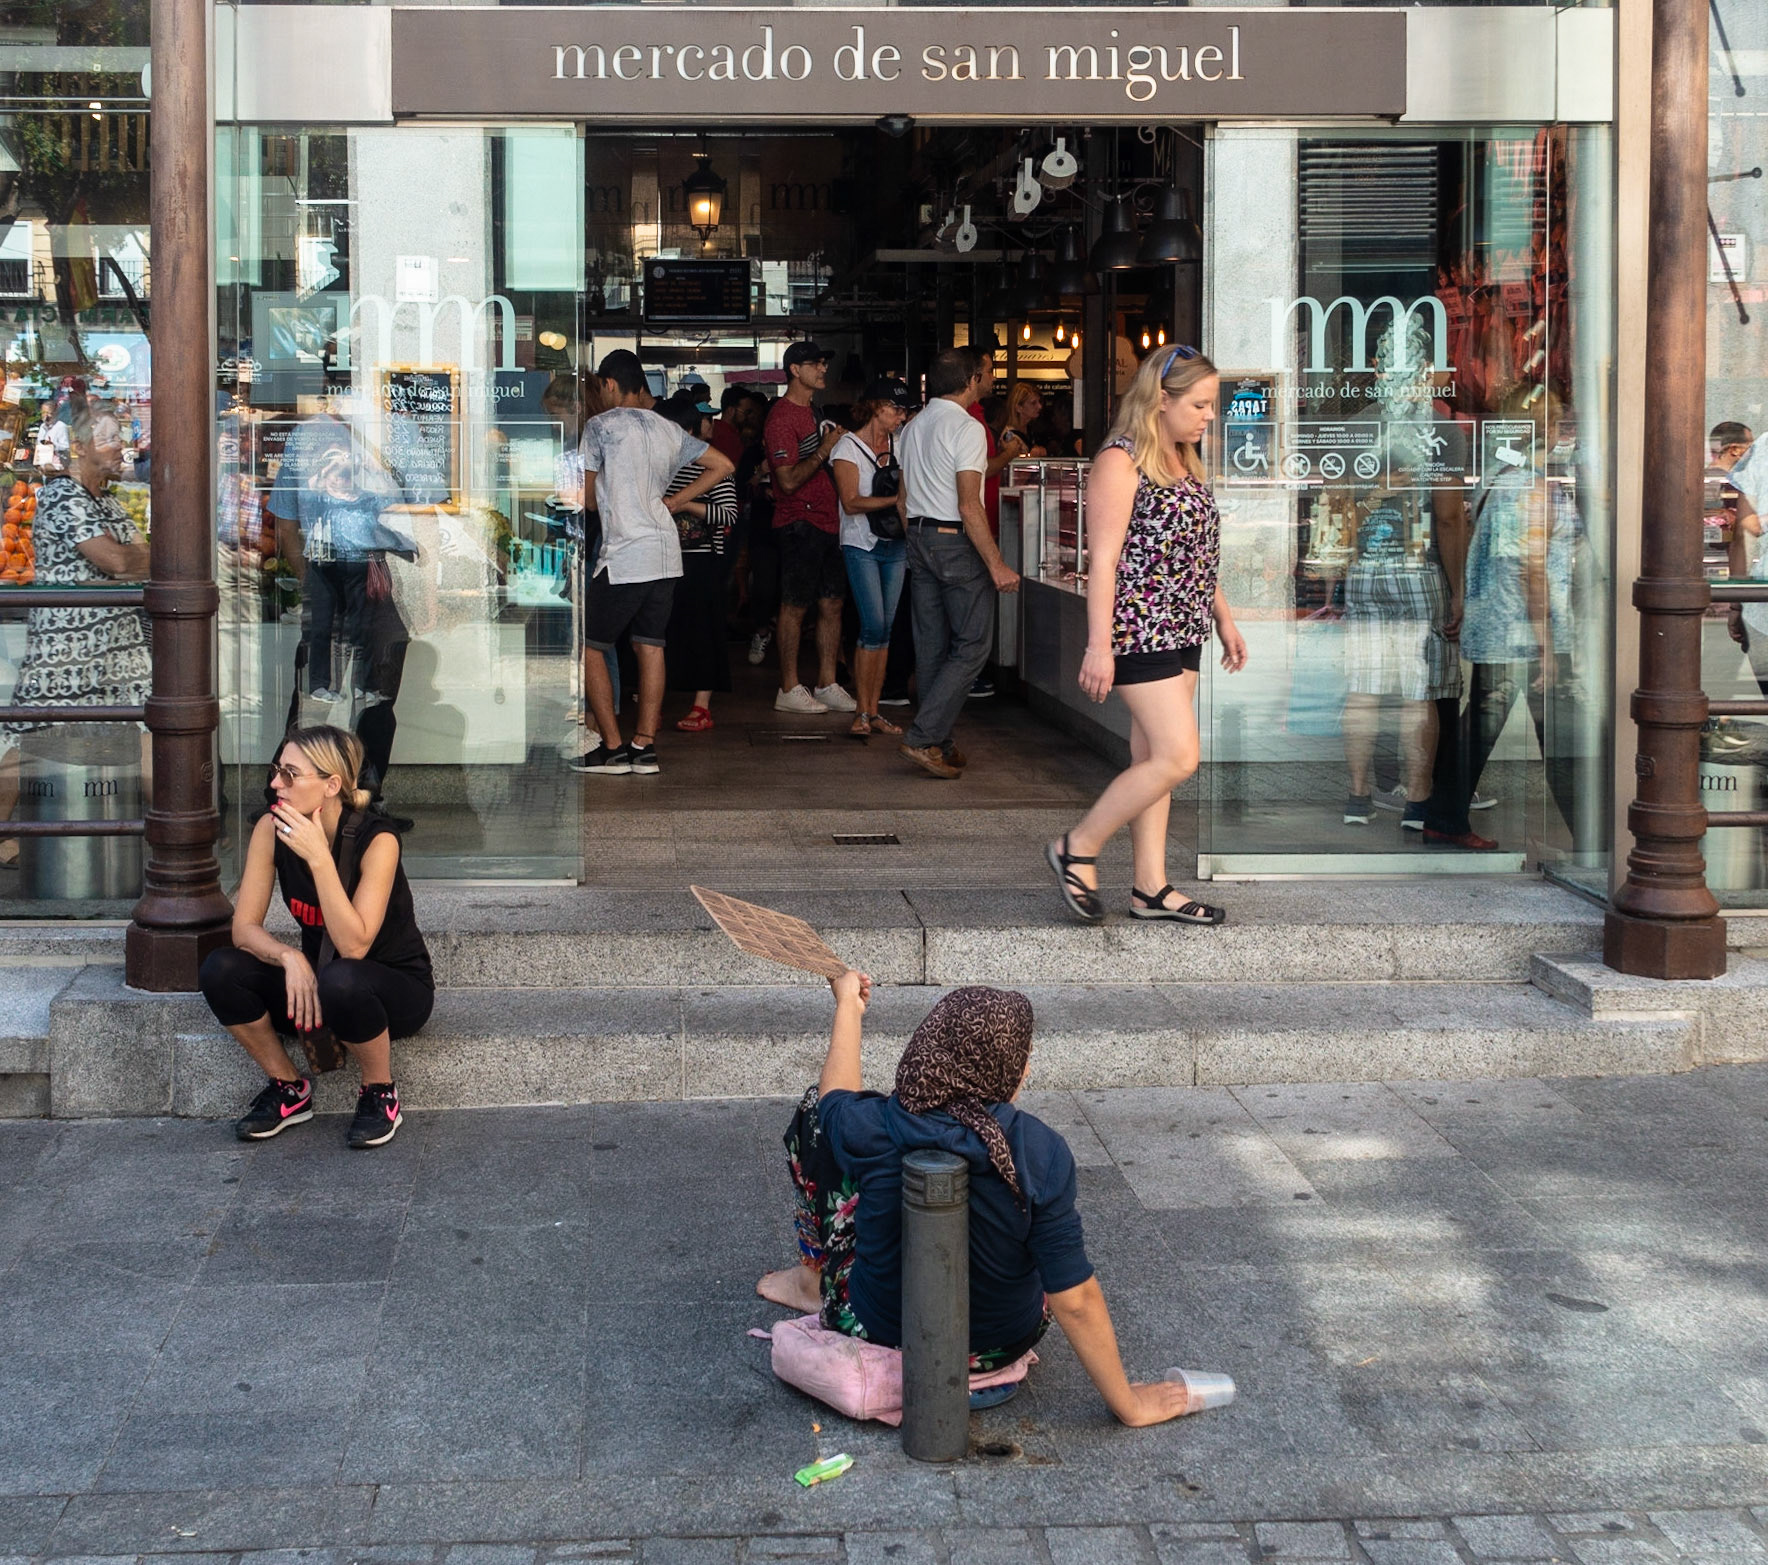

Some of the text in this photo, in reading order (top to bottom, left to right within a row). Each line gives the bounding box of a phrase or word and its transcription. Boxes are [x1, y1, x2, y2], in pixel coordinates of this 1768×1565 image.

[550, 25, 1245, 101] mercado de san miguel
[469, 383, 526, 403] miguel
[1261, 381, 1336, 399] mercado
[1340, 381, 1360, 399] de
[1365, 387, 1393, 399] san
[1400, 381, 1457, 403] miguel
[289, 897, 324, 927] PU
